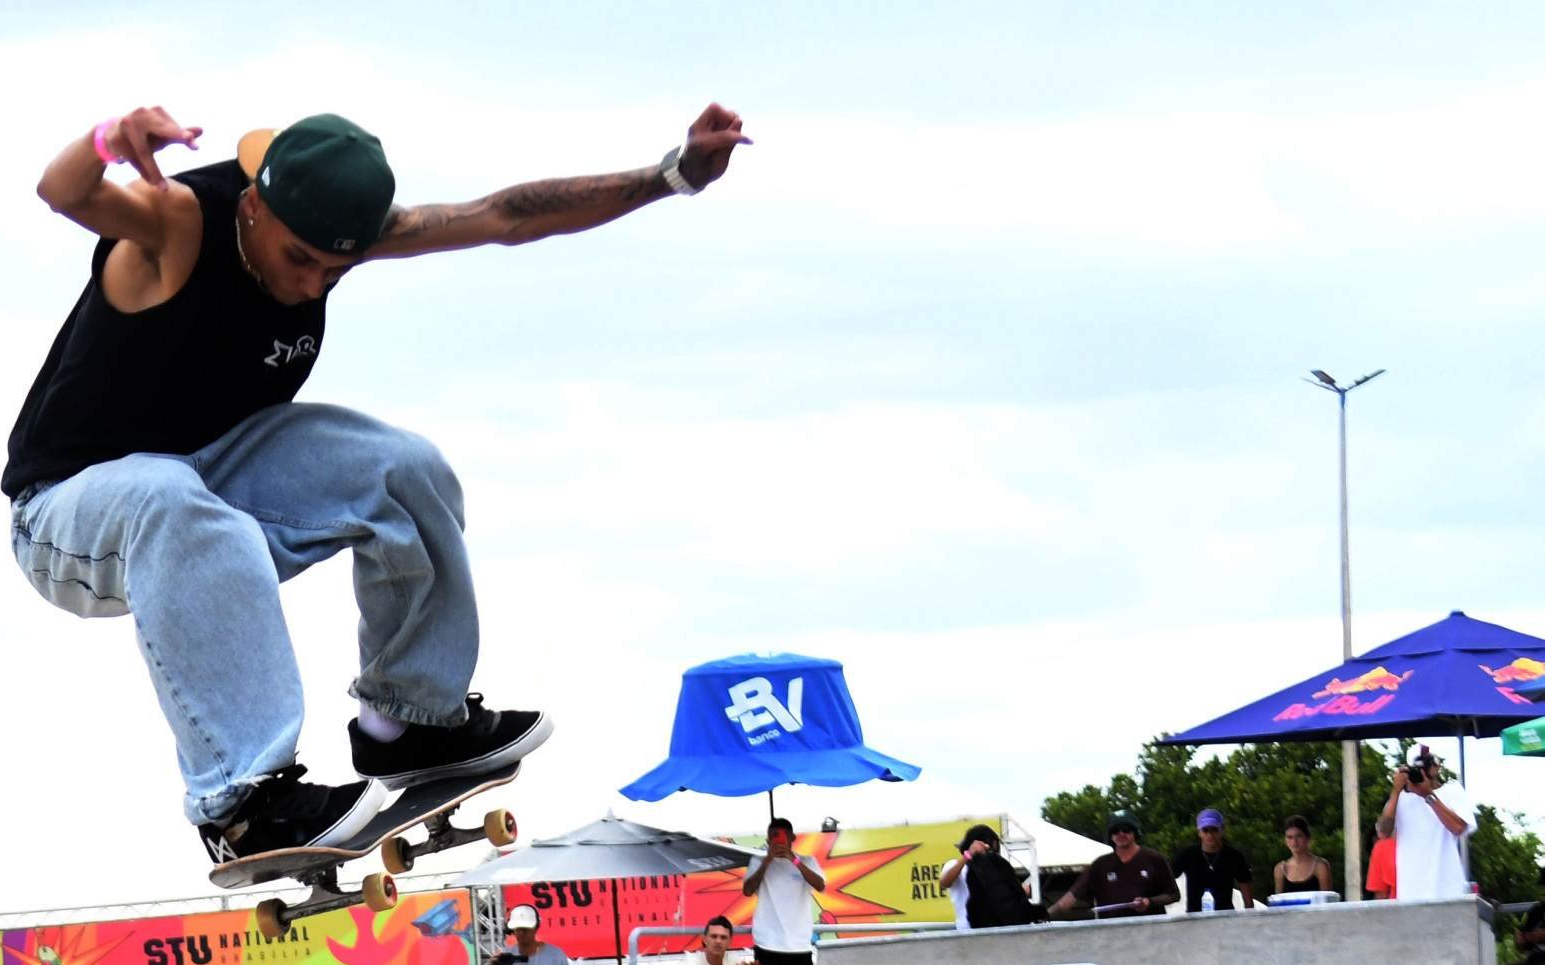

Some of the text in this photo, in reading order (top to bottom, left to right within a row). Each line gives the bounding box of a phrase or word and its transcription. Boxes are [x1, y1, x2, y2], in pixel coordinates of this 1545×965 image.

[724, 676, 804, 733] BV
[747, 729, 782, 747] banco
[910, 862, 944, 882] ÁRE
[599, 875, 681, 894] NTIONAL
[531, 880, 593, 909] STU
[547, 914, 602, 929] TREET
